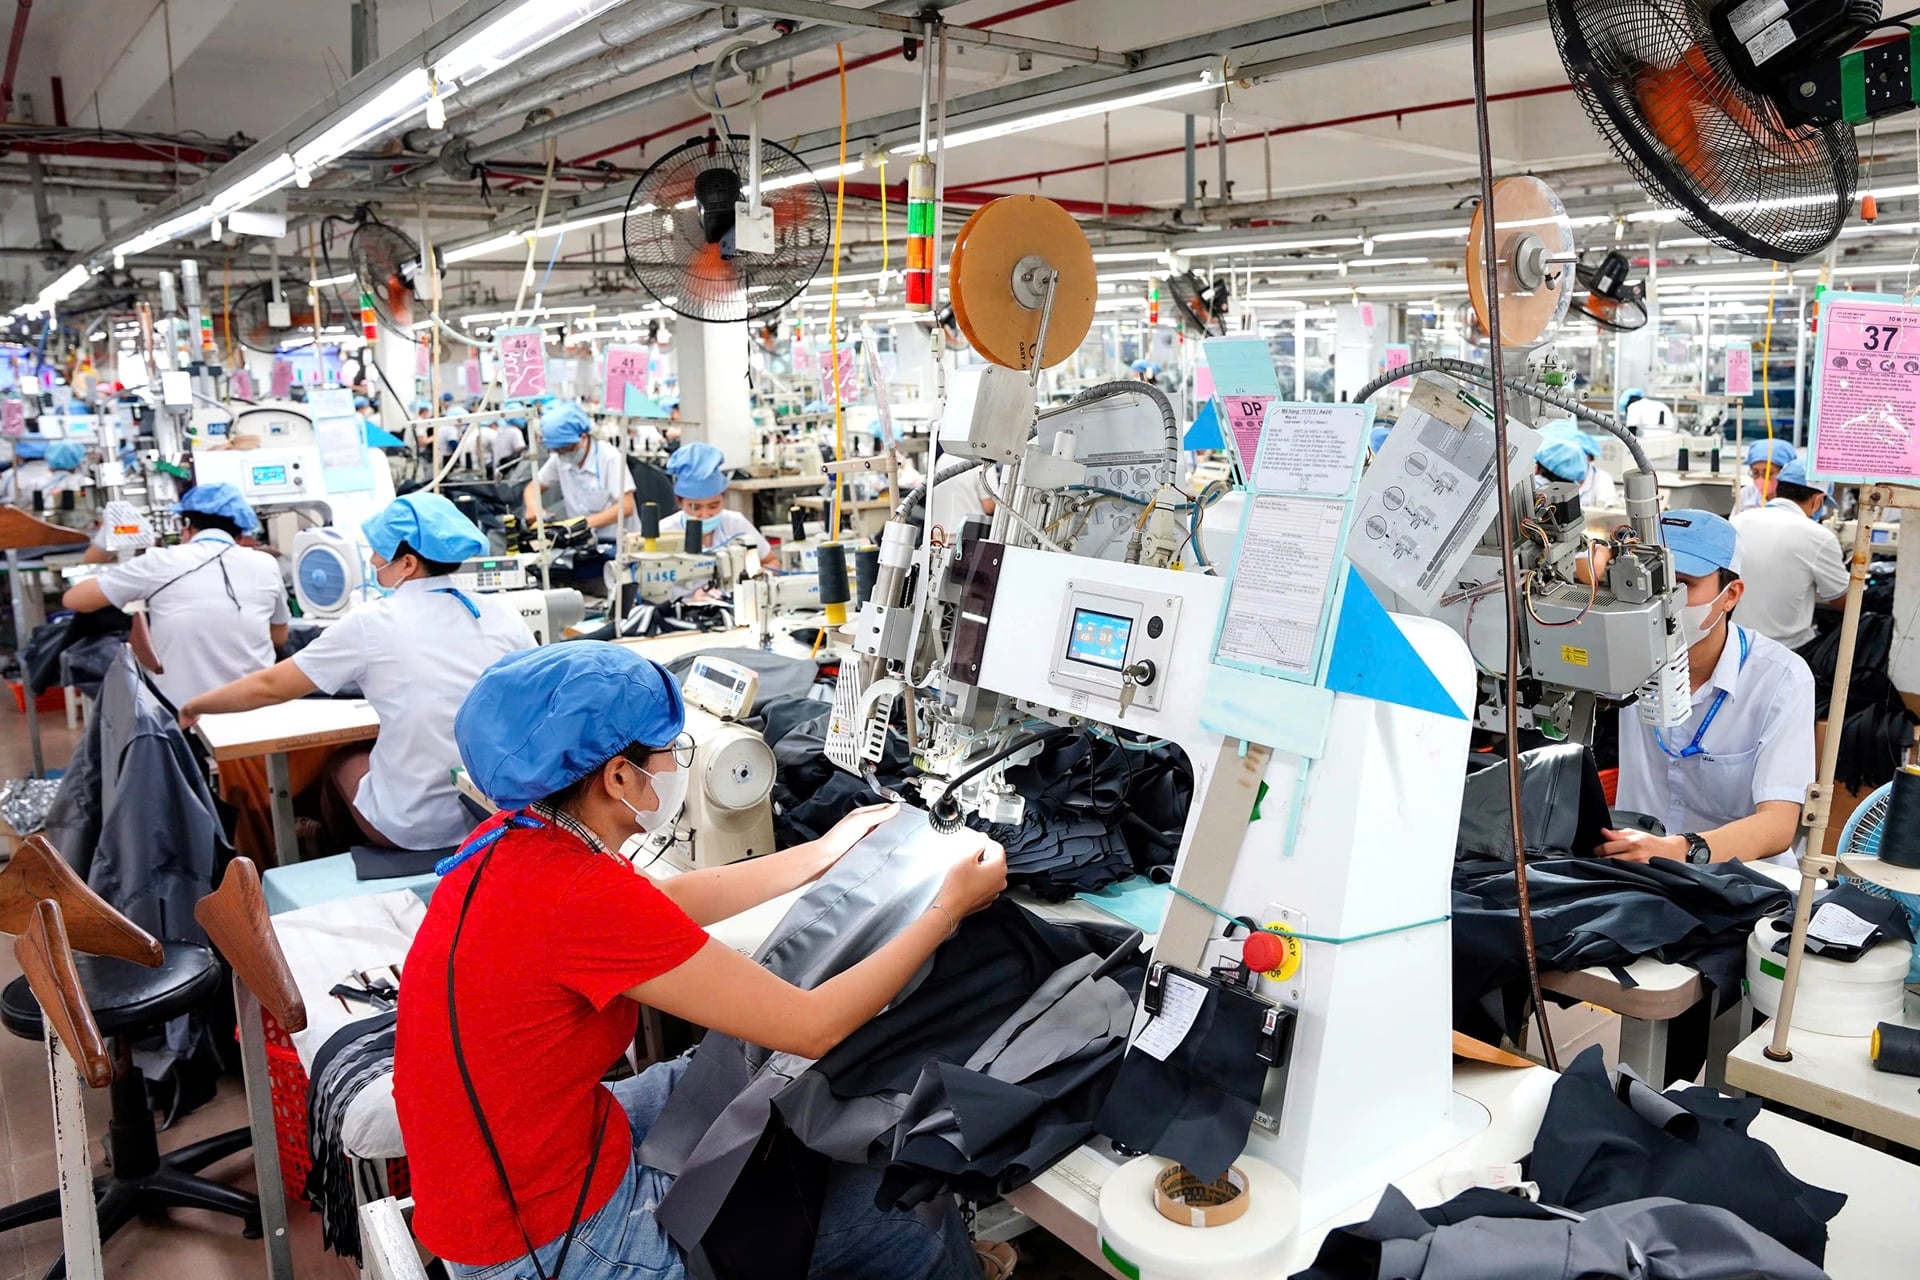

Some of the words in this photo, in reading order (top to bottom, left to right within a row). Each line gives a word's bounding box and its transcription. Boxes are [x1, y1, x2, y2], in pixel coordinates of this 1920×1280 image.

[1863, 325, 1898, 351] 37
[621, 358, 635, 368] 41
[1241, 401, 1262, 417] DP
[1254, 1114, 1267, 1126] LER
